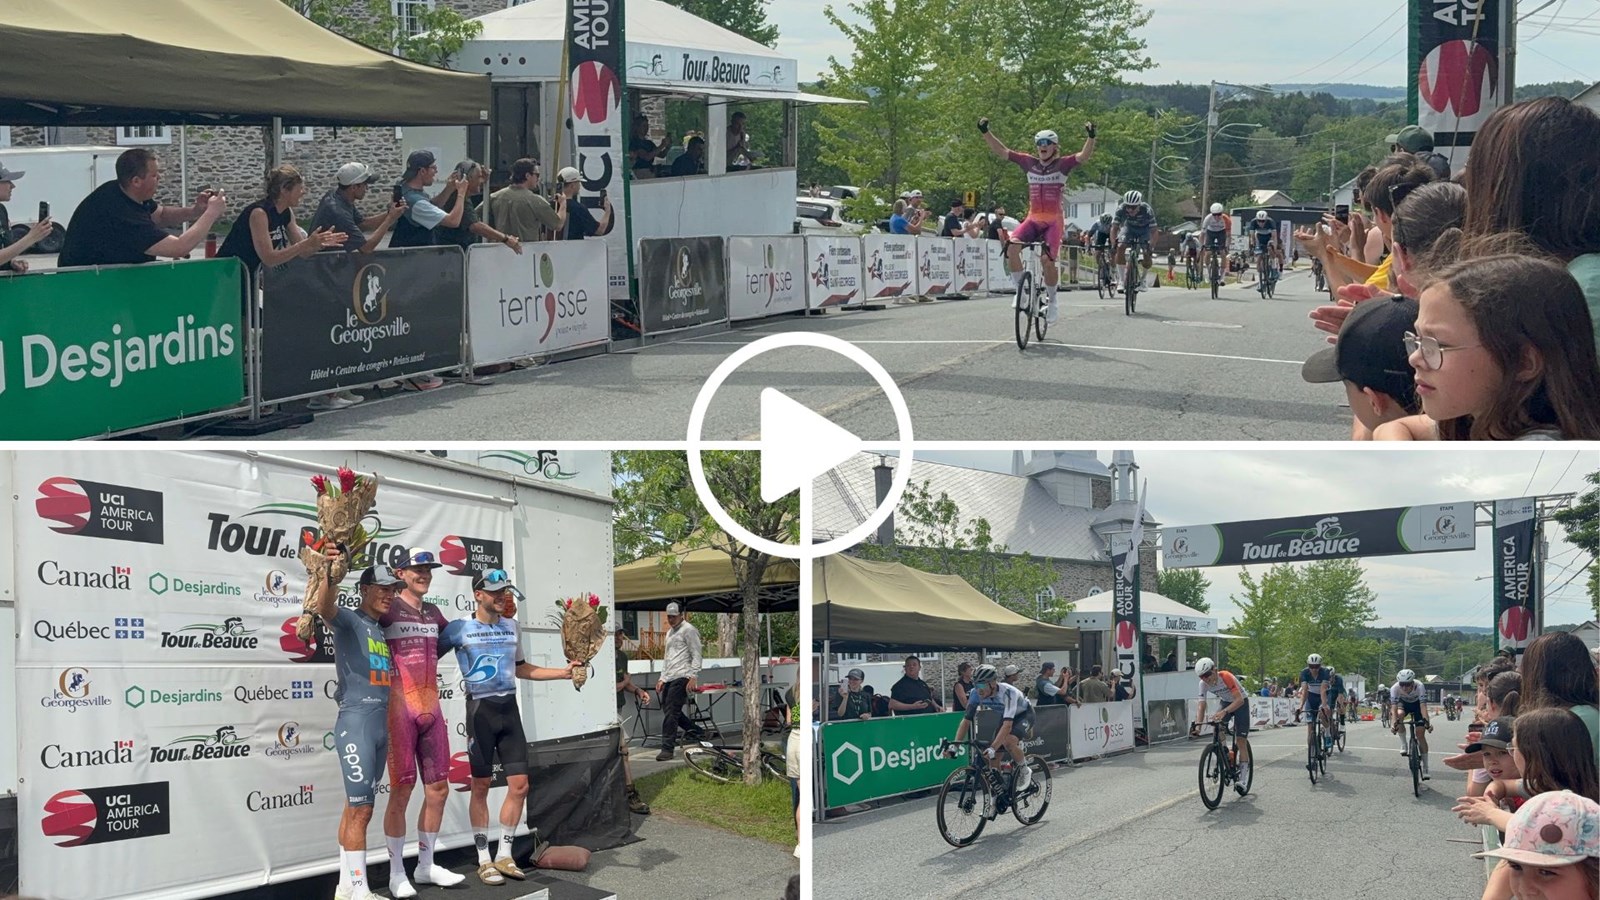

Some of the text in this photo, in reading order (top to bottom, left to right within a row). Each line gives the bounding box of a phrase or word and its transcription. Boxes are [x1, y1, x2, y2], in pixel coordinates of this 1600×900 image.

[682, 53, 708, 81] Tour
[712, 56, 751, 85] Beauce
[346, 308, 359, 329] le
[330, 316, 412, 354] Georgesville
[22, 314, 235, 388] Desjardins
[310, 368, 330, 381] Hôtel
[335, 364, 357, 376] Centre
[100, 492, 125, 506] UCI
[100, 505, 154, 522] AMERICA
[100, 518, 133, 532] TOUR
[207, 512, 286, 557] Tour
[280, 544, 296, 559] de
[1423, 530, 1471, 544] Georgesville
[470, 544, 484, 554] UCI
[1242, 542, 1282, 560] Tour
[1287, 537, 1360, 557] Beauce
[471, 553, 499, 564] AMERICA
[1504, 535, 1516, 600] AMERICA
[37, 559, 132, 591] Canada
[1517, 561, 1529, 601] TOUR
[173, 578, 242, 596] Desjardins
[1115, 563, 1125, 616] AMERICA
[253, 592, 304, 608] Georgesville
[338, 593, 361, 608] Bea
[424, 595, 450, 607] ardins
[1124, 585, 1134, 617] TOUR
[34, 619, 111, 642] Québec
[1165, 616, 1178, 630] Tour
[161, 632, 196, 649] Tour
[202, 631, 259, 649] Beauce
[54, 688, 64, 699] le
[150, 689, 223, 706] Desjardins
[234, 685, 289, 703] Québec
[40, 695, 113, 713] Georgesville
[40, 740, 134, 770] Canada
[150, 746, 187, 763] Tour
[191, 744, 251, 760] Beauce
[265, 744, 315, 760] Georgesville
[869, 737, 966, 772] Desjards
[105, 794, 131, 807] UCI
[246, 785, 313, 812] Canada
[106, 803, 160, 820] AMERICA
[106, 818, 140, 832] TOUR
